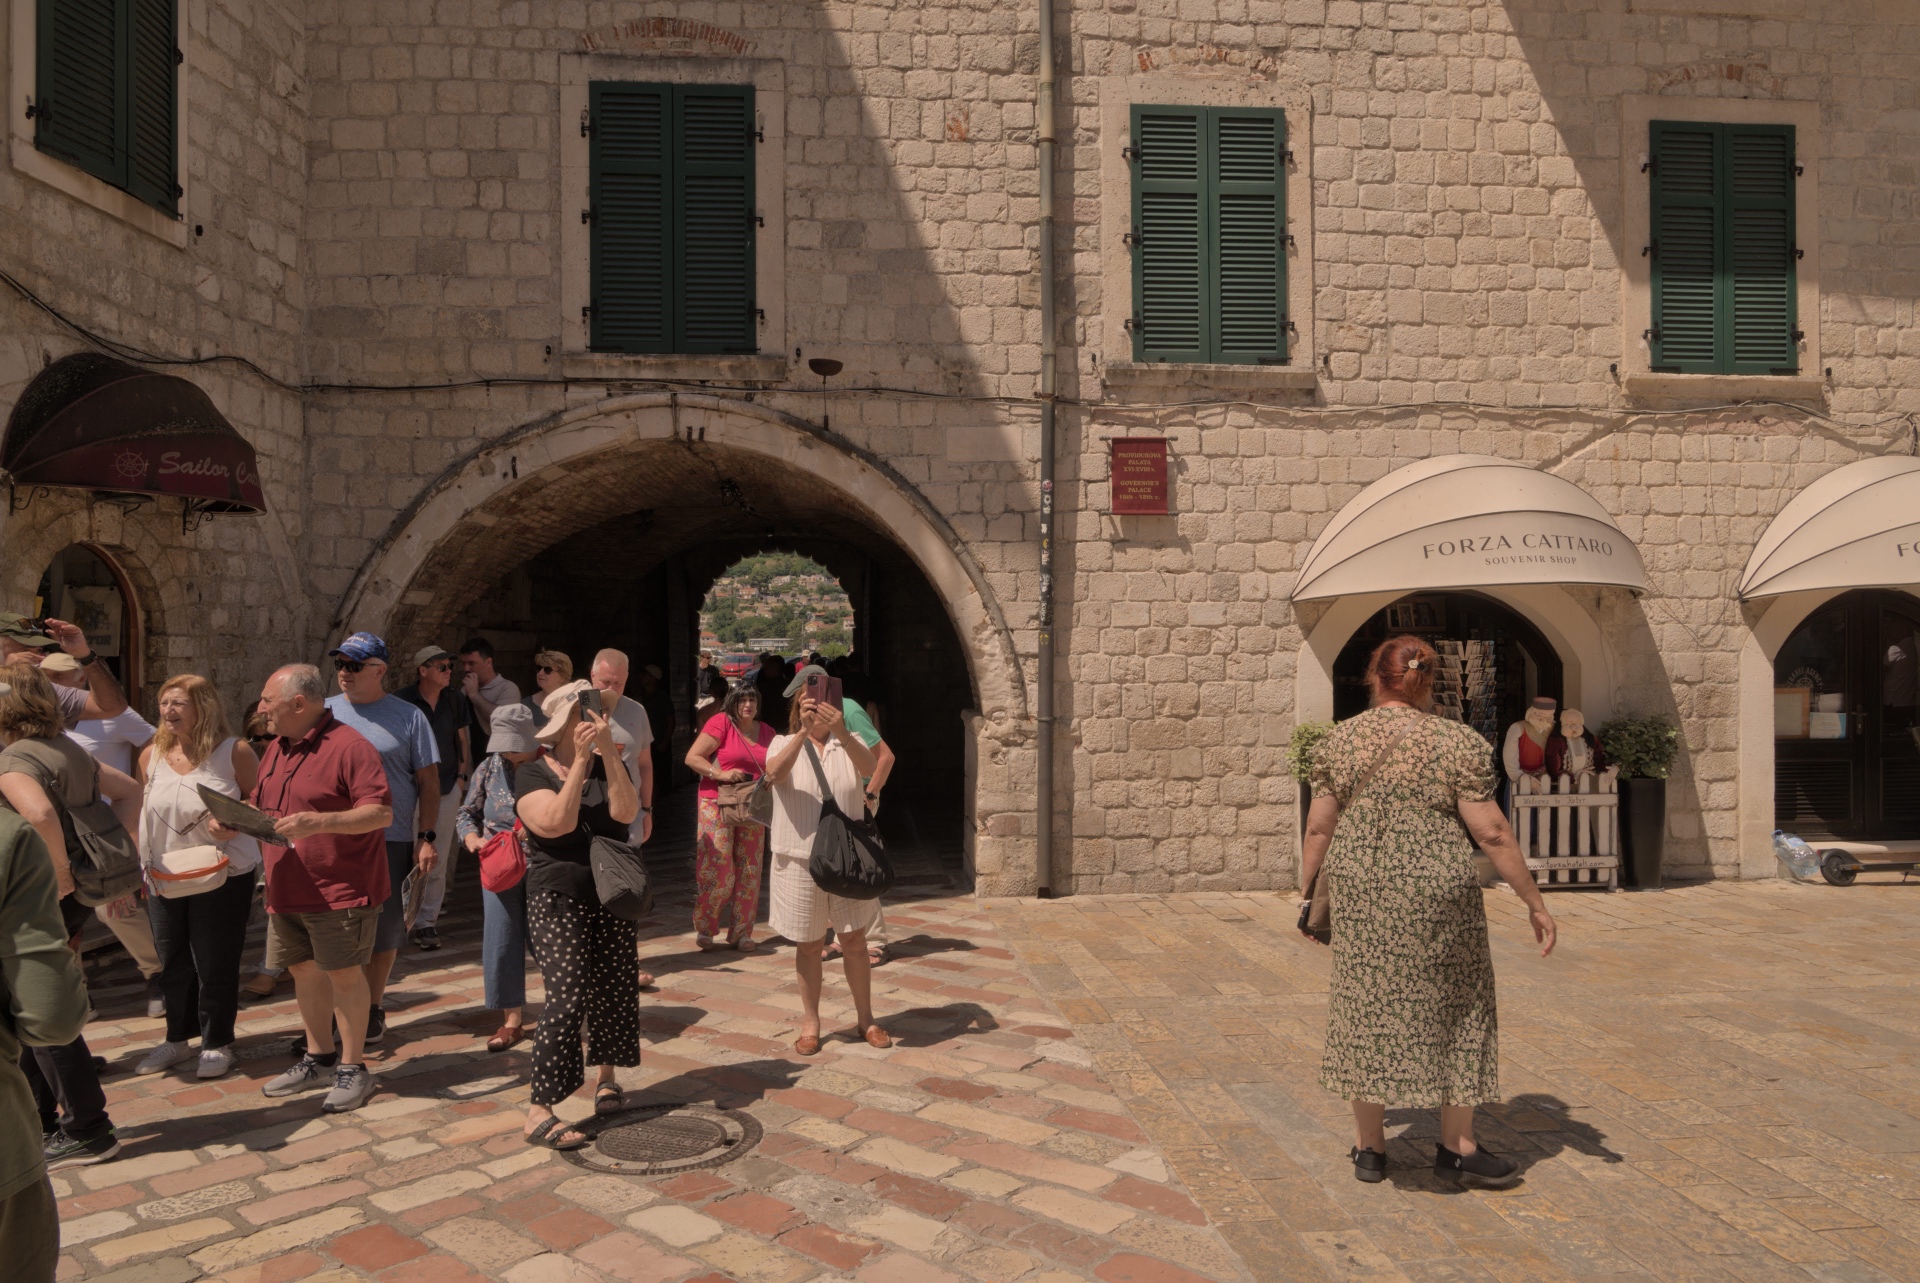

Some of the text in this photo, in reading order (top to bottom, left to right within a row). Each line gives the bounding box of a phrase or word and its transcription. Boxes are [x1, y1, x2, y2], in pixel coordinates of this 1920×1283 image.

[158, 451, 229, 478] Sailor
[1422, 533, 1613, 559] FORZA CATTARO
[1485, 555, 1577, 566] SOUVENIR SHOP
[1786, 666, 1824, 686] TRAVEL AGENCY
[1523, 797, 1550, 805] Welcome
[1567, 796, 1586, 804] Kotor
